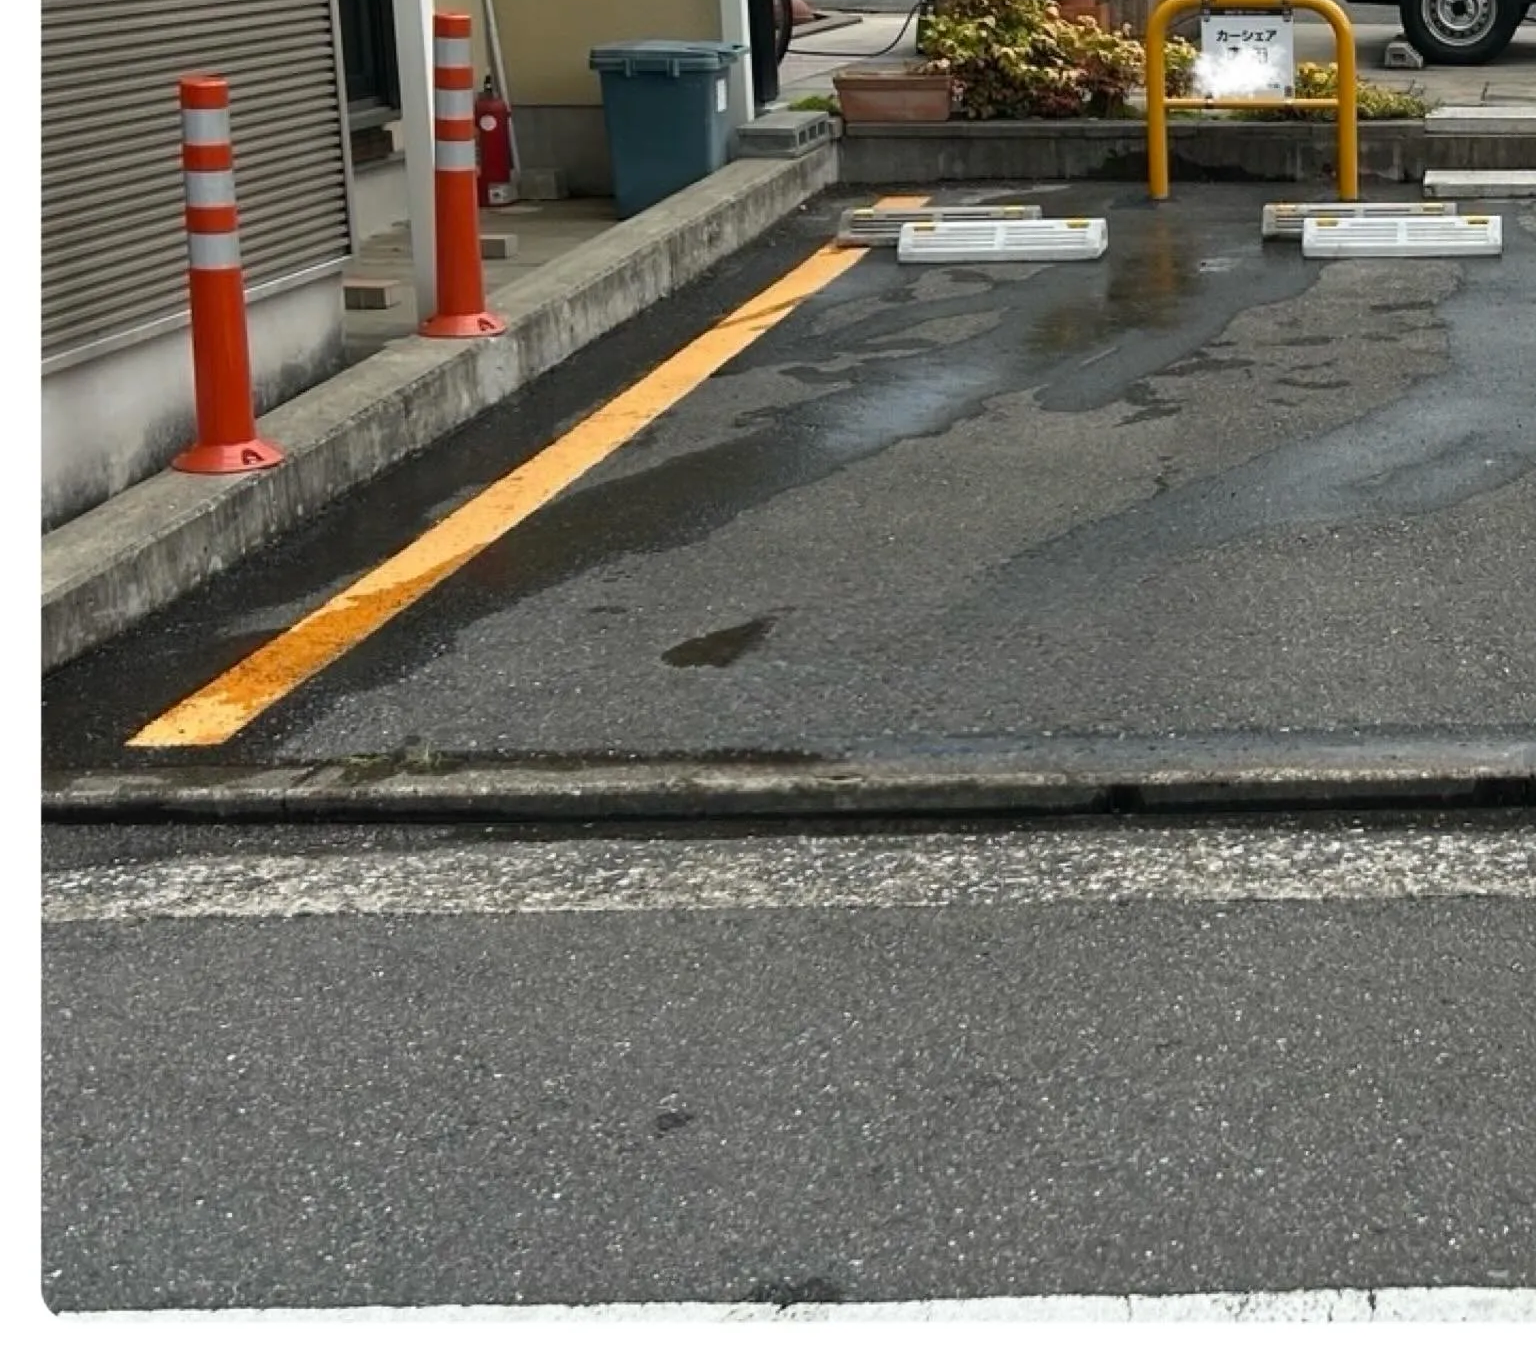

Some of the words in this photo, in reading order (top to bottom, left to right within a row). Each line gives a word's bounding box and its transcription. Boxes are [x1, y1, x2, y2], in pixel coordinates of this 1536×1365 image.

[1216, 29, 1277, 42] カーシェア
